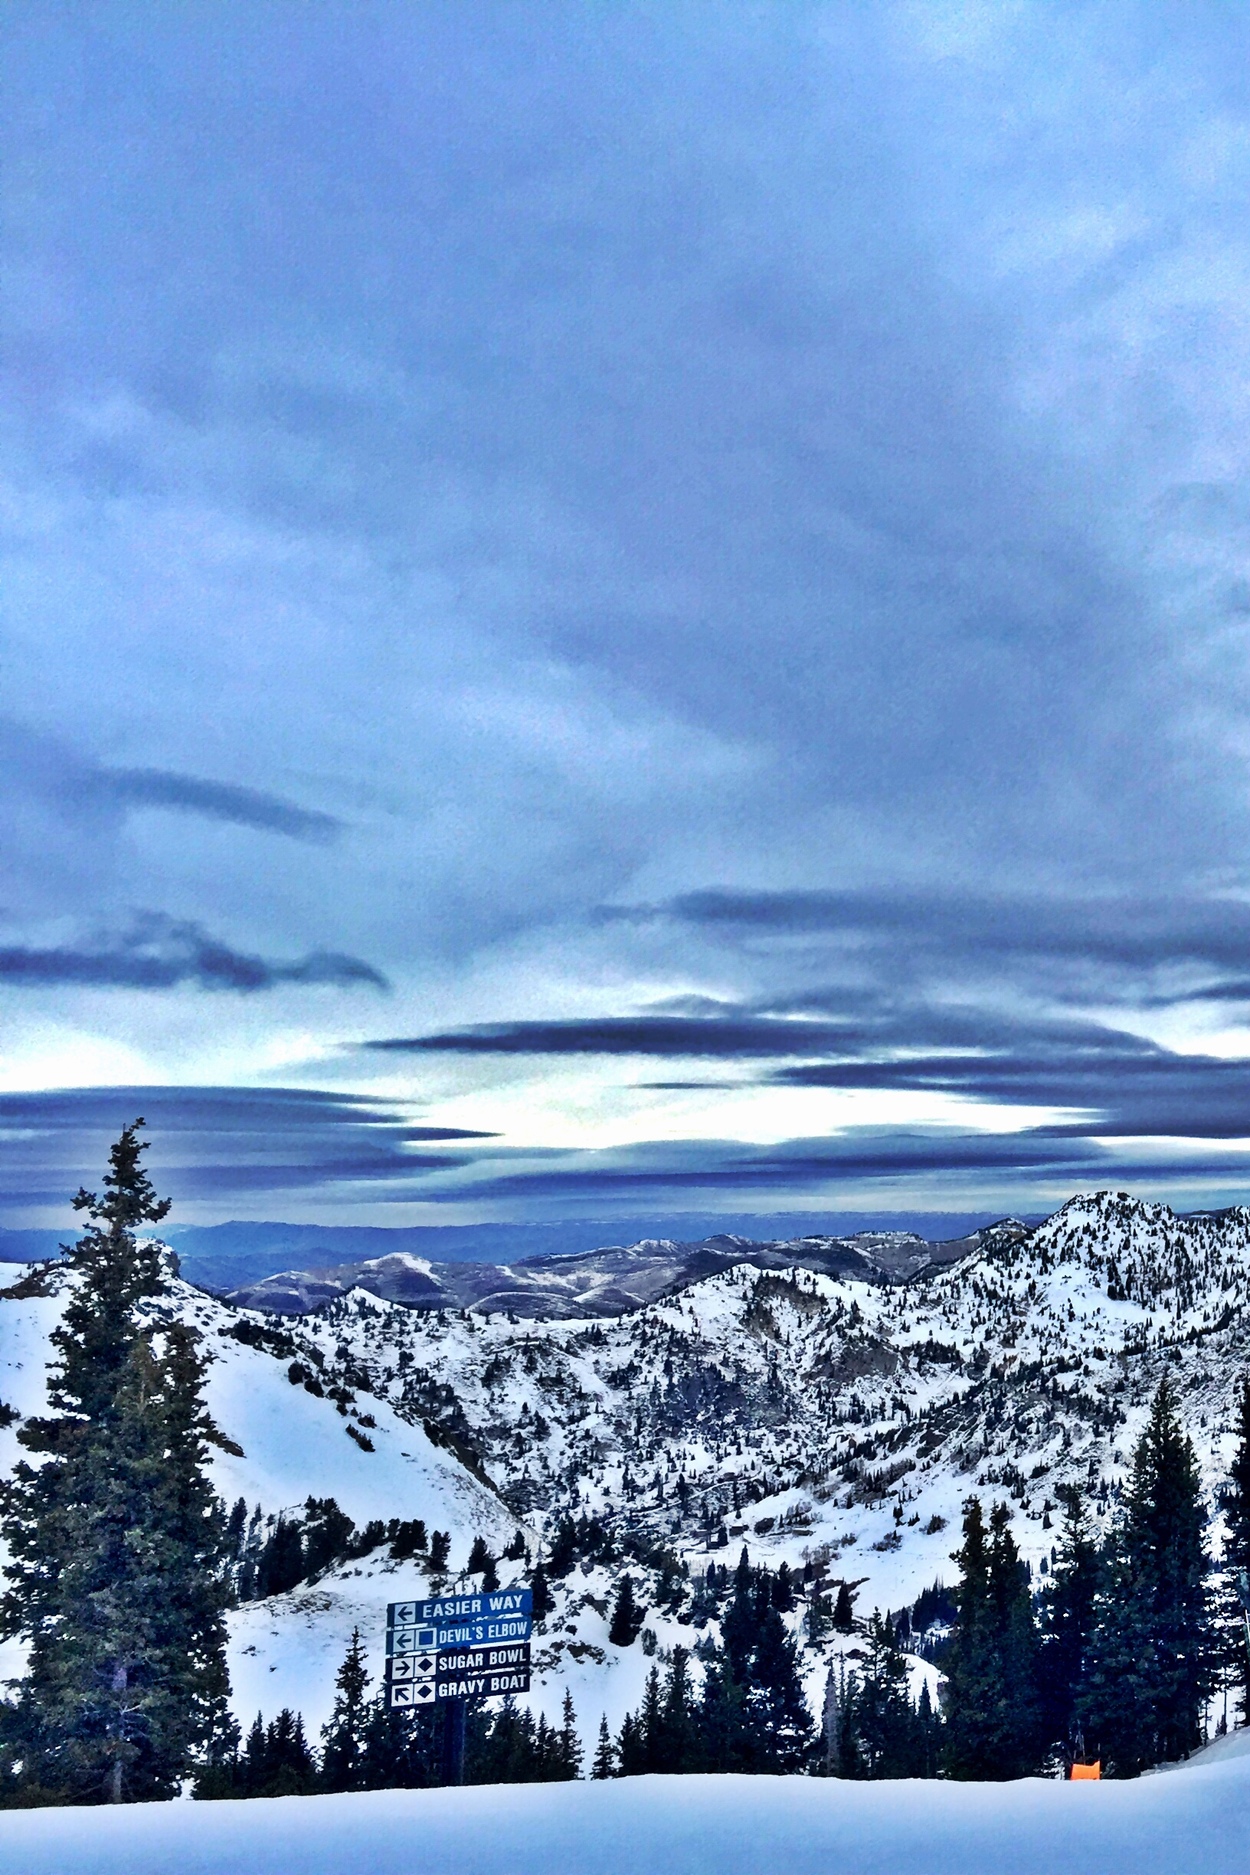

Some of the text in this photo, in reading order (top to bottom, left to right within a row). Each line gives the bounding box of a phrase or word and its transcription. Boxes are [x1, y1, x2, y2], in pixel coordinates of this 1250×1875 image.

[422, 1595, 523, 1618] EASIER WAY
[439, 1621, 527, 1644] DEVIL'S ELBOW
[438, 1648, 526, 1671] SUGAR BOWL
[438, 1674, 526, 1697] GRAVY BOAT
